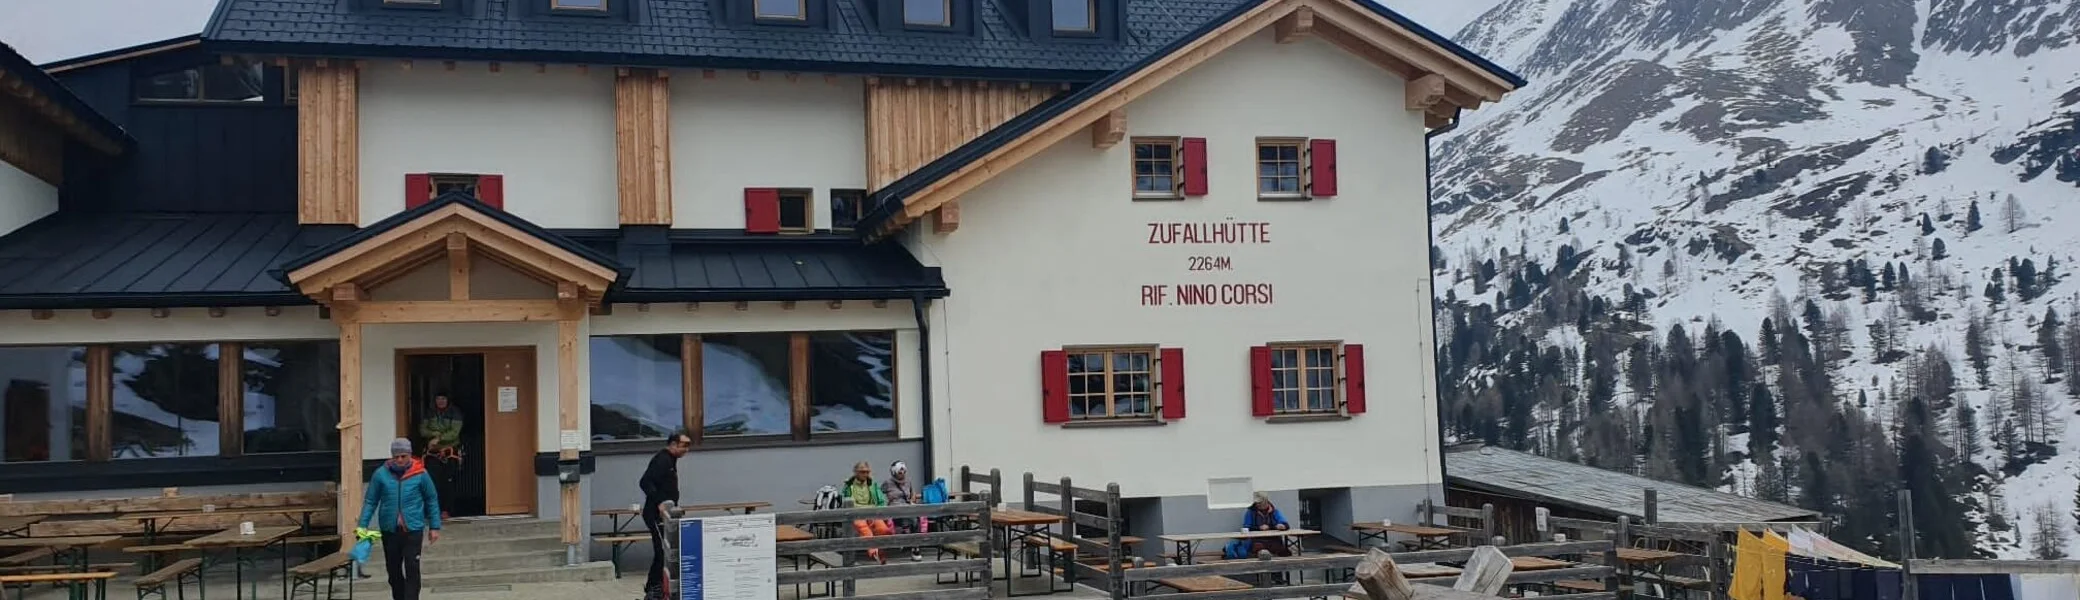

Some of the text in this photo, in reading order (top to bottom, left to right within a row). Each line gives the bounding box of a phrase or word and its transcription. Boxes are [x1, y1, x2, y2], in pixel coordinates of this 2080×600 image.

[1148, 217, 1271, 244] ZUFALLHÜTTE
[1188, 256, 1233, 271] 2264M.
[1141, 283, 1273, 306] RIF. NINO CORSI
